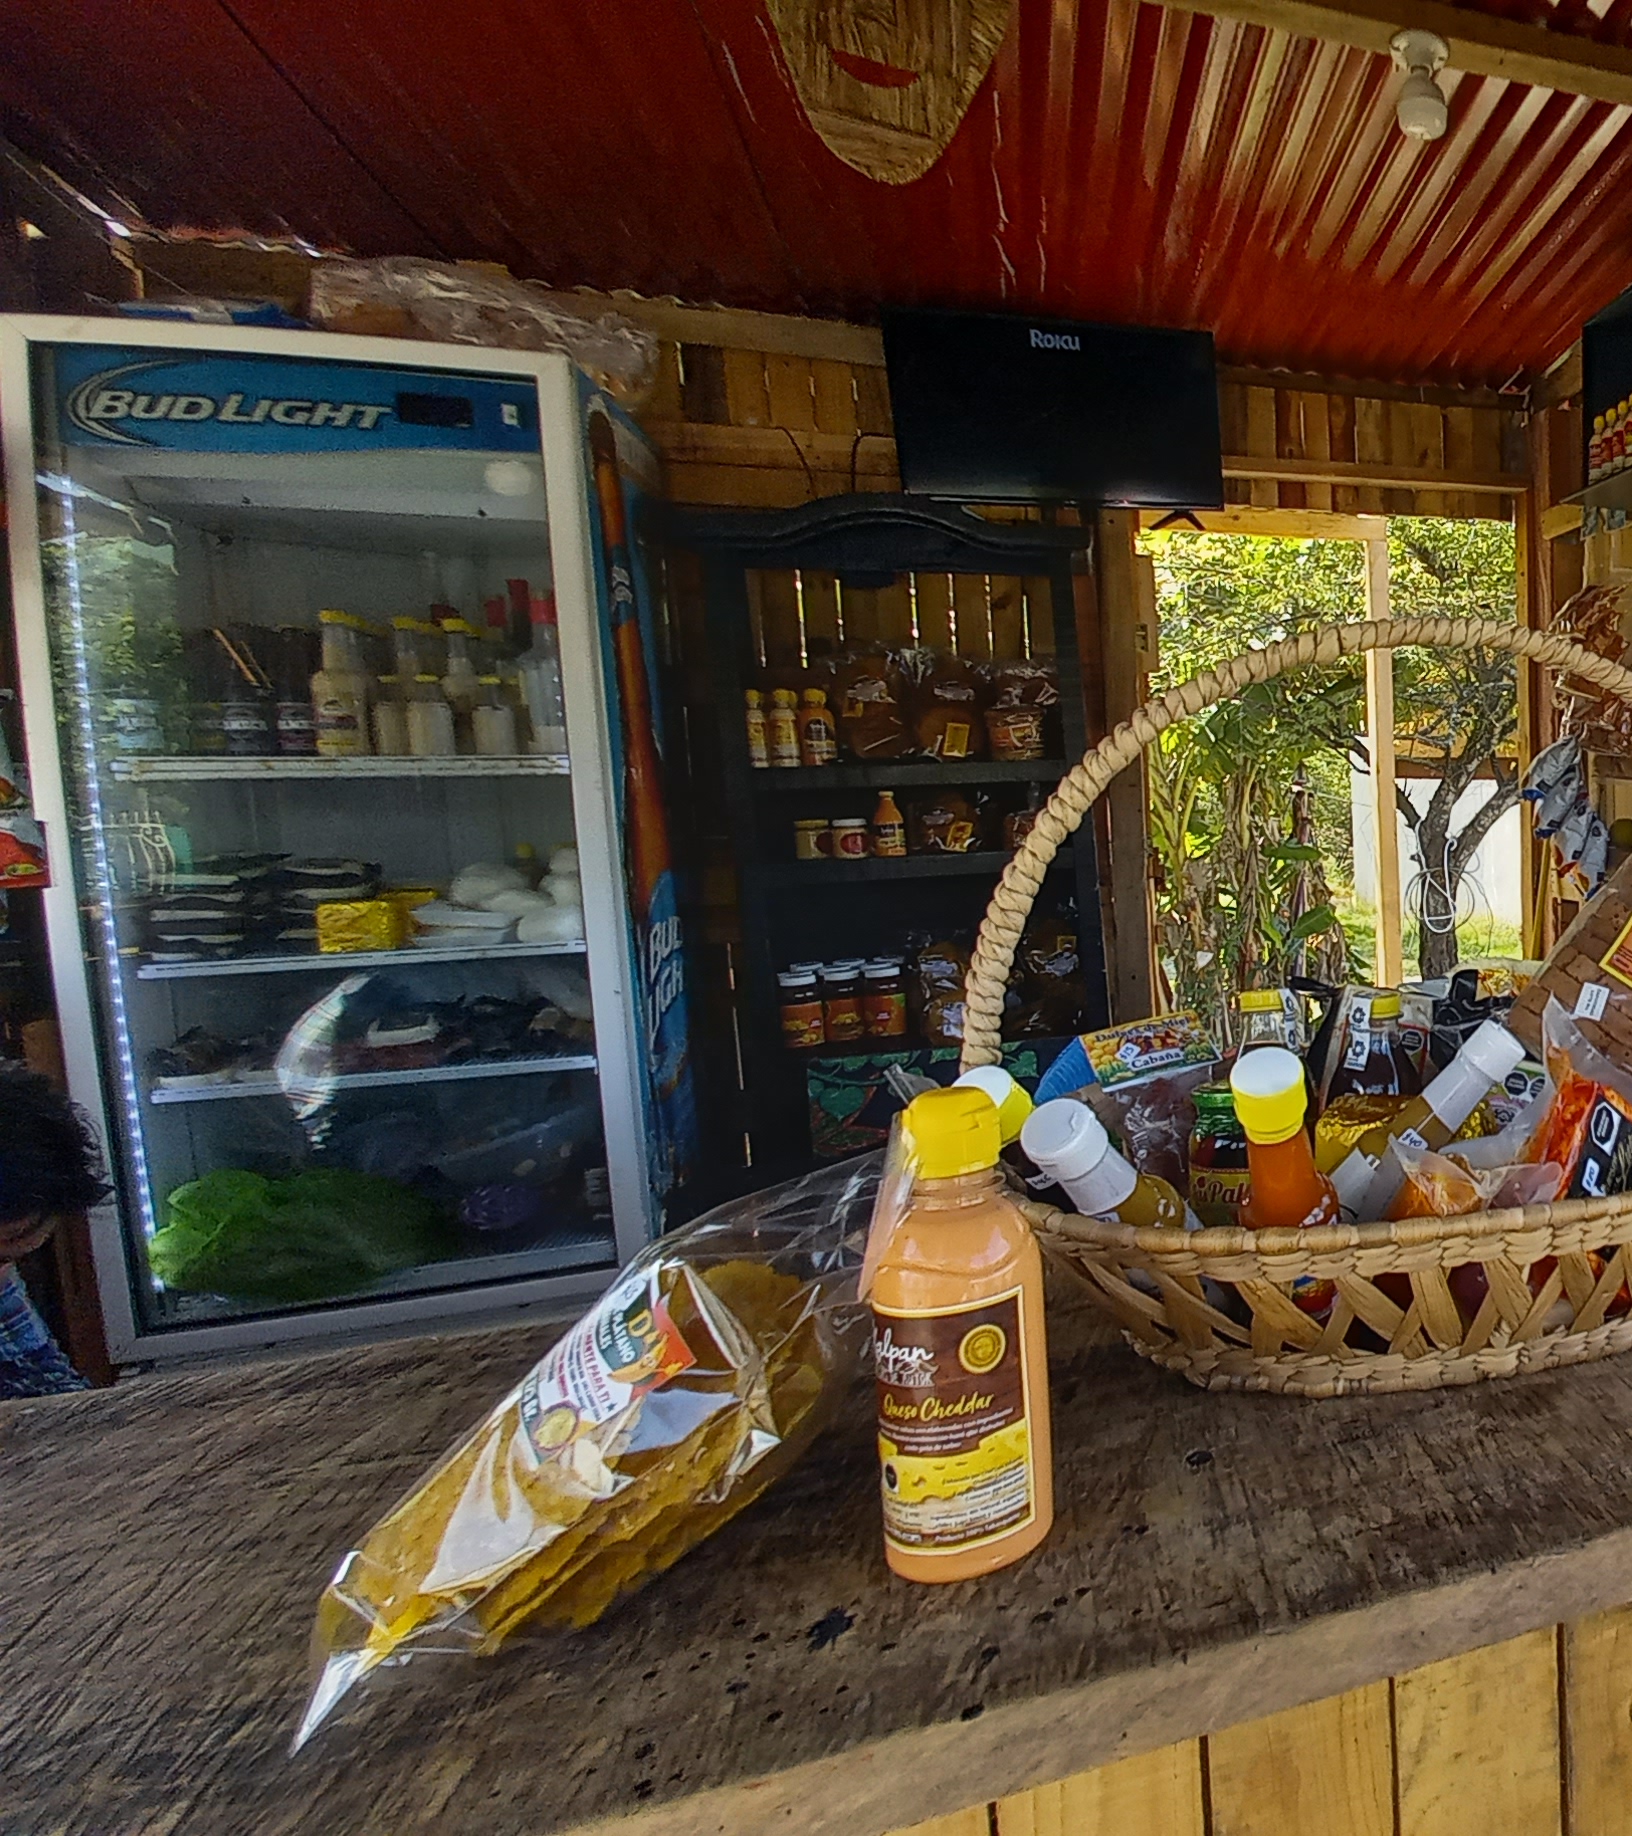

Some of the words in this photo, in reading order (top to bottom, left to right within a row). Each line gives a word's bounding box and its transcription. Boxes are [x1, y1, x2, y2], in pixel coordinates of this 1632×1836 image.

[88, 390, 216, 421] BUD
[215, 393, 394, 430] LIGHT
[1132, 1051, 1182, 1069] Cabaña
[883, 1392, 918, 1421] Queso
[920, 1391, 994, 1422] Cheddar
